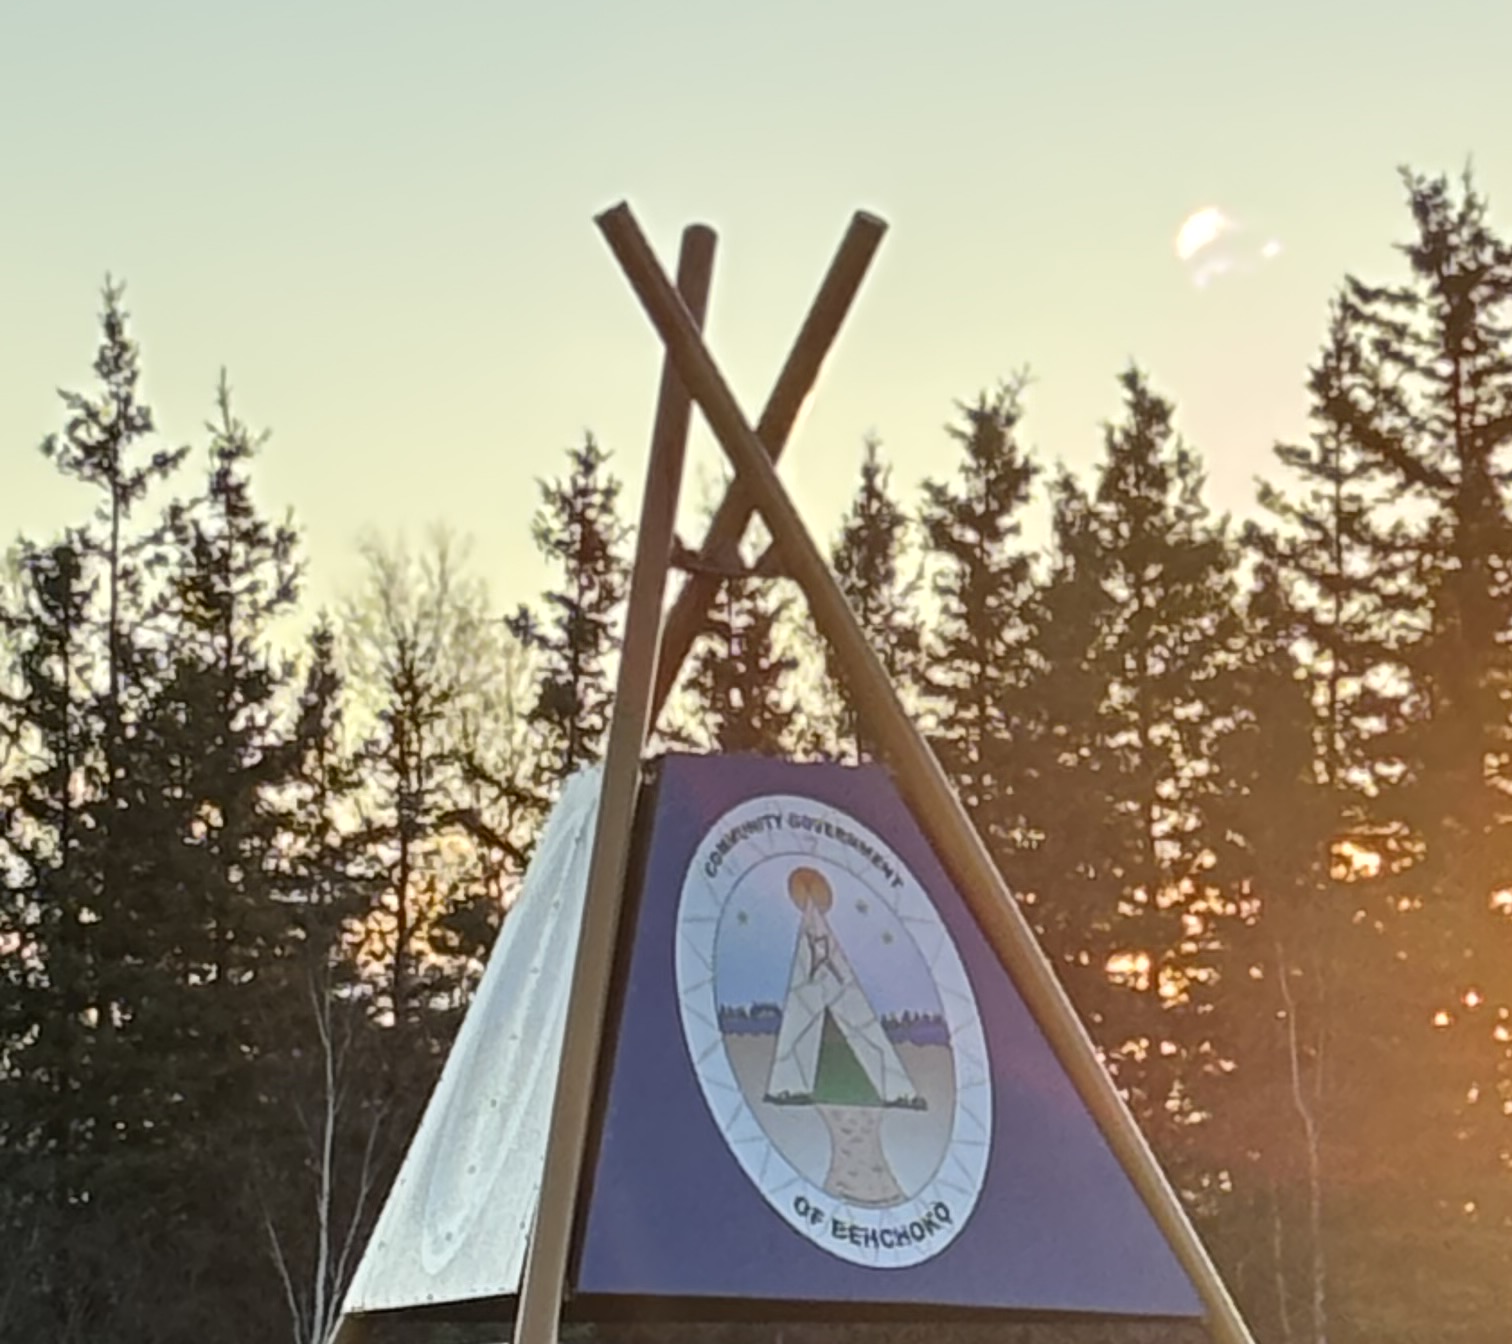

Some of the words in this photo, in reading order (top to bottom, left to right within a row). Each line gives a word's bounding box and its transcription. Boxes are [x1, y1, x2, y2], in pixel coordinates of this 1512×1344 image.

[705, 813, 783, 878] COMMUNITY
[788, 813, 904, 888] GOVERNMENT
[794, 1196, 824, 1226] OF
